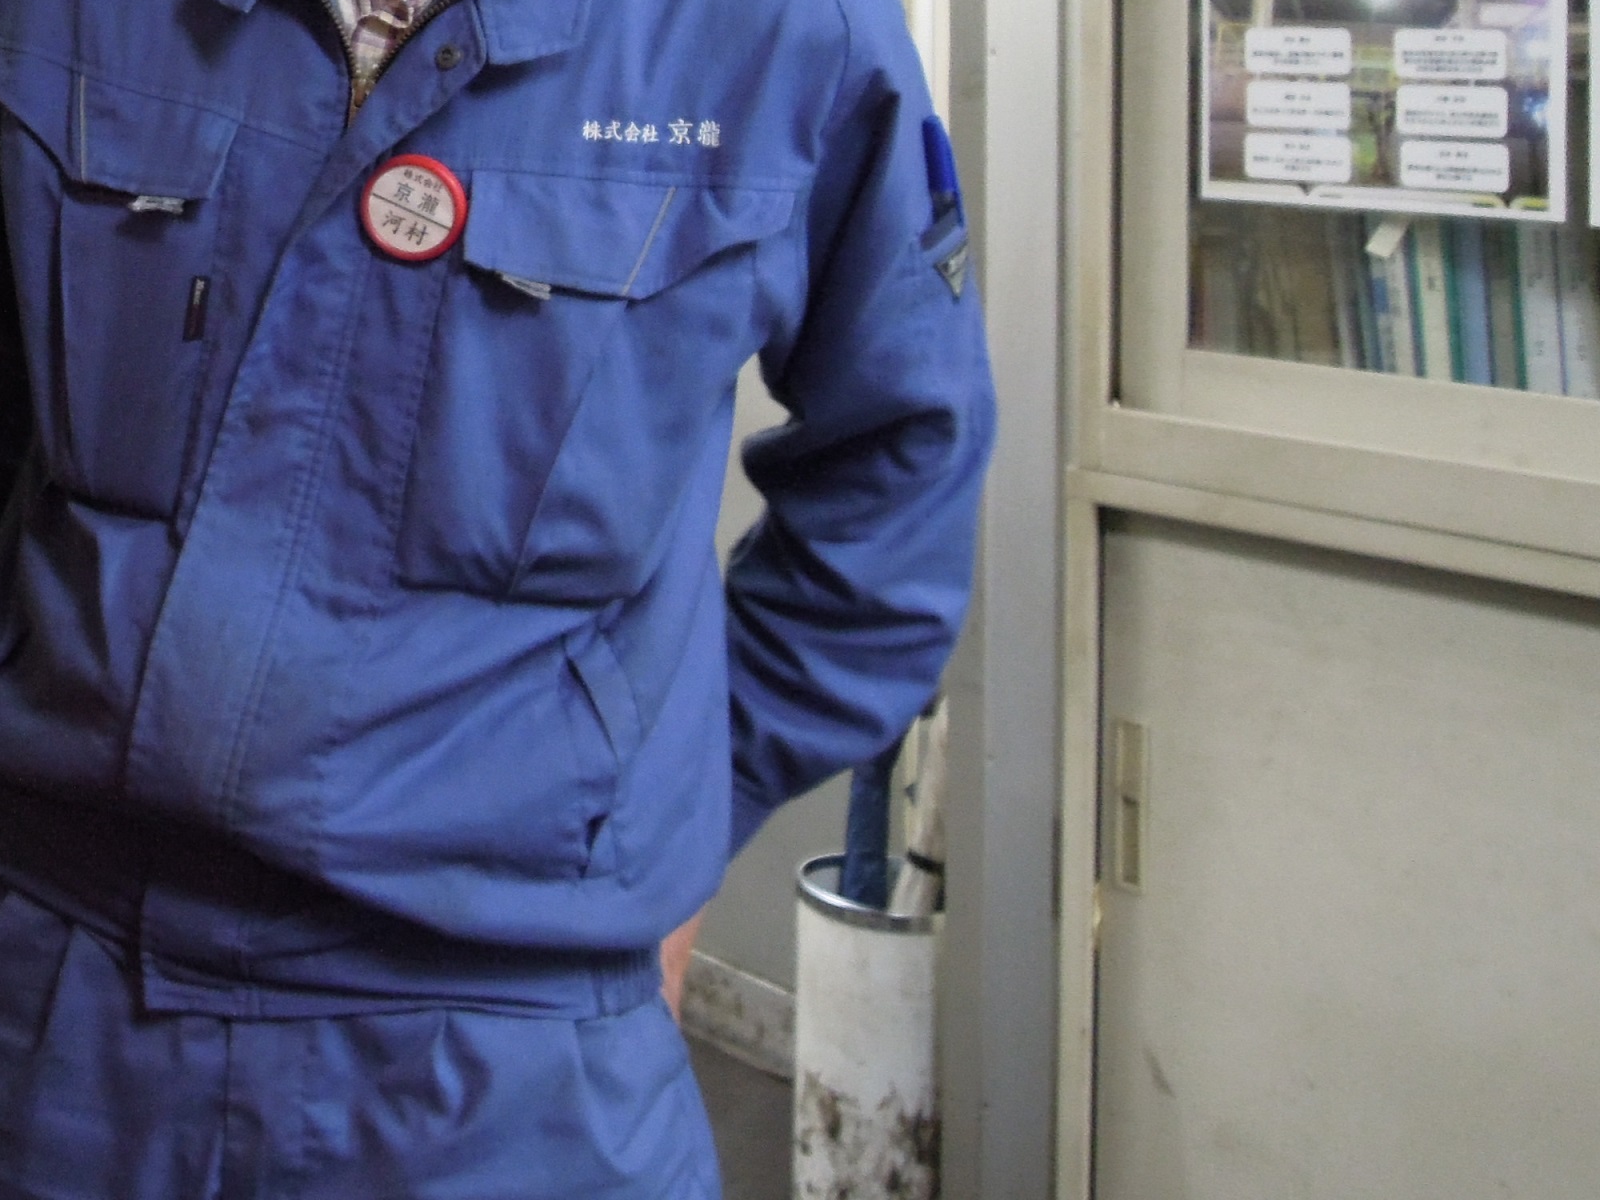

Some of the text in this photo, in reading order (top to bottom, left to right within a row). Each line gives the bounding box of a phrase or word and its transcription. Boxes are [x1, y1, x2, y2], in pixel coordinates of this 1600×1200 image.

[582, 120, 660, 143] 株式会社
[382, 209, 429, 246] 河村
